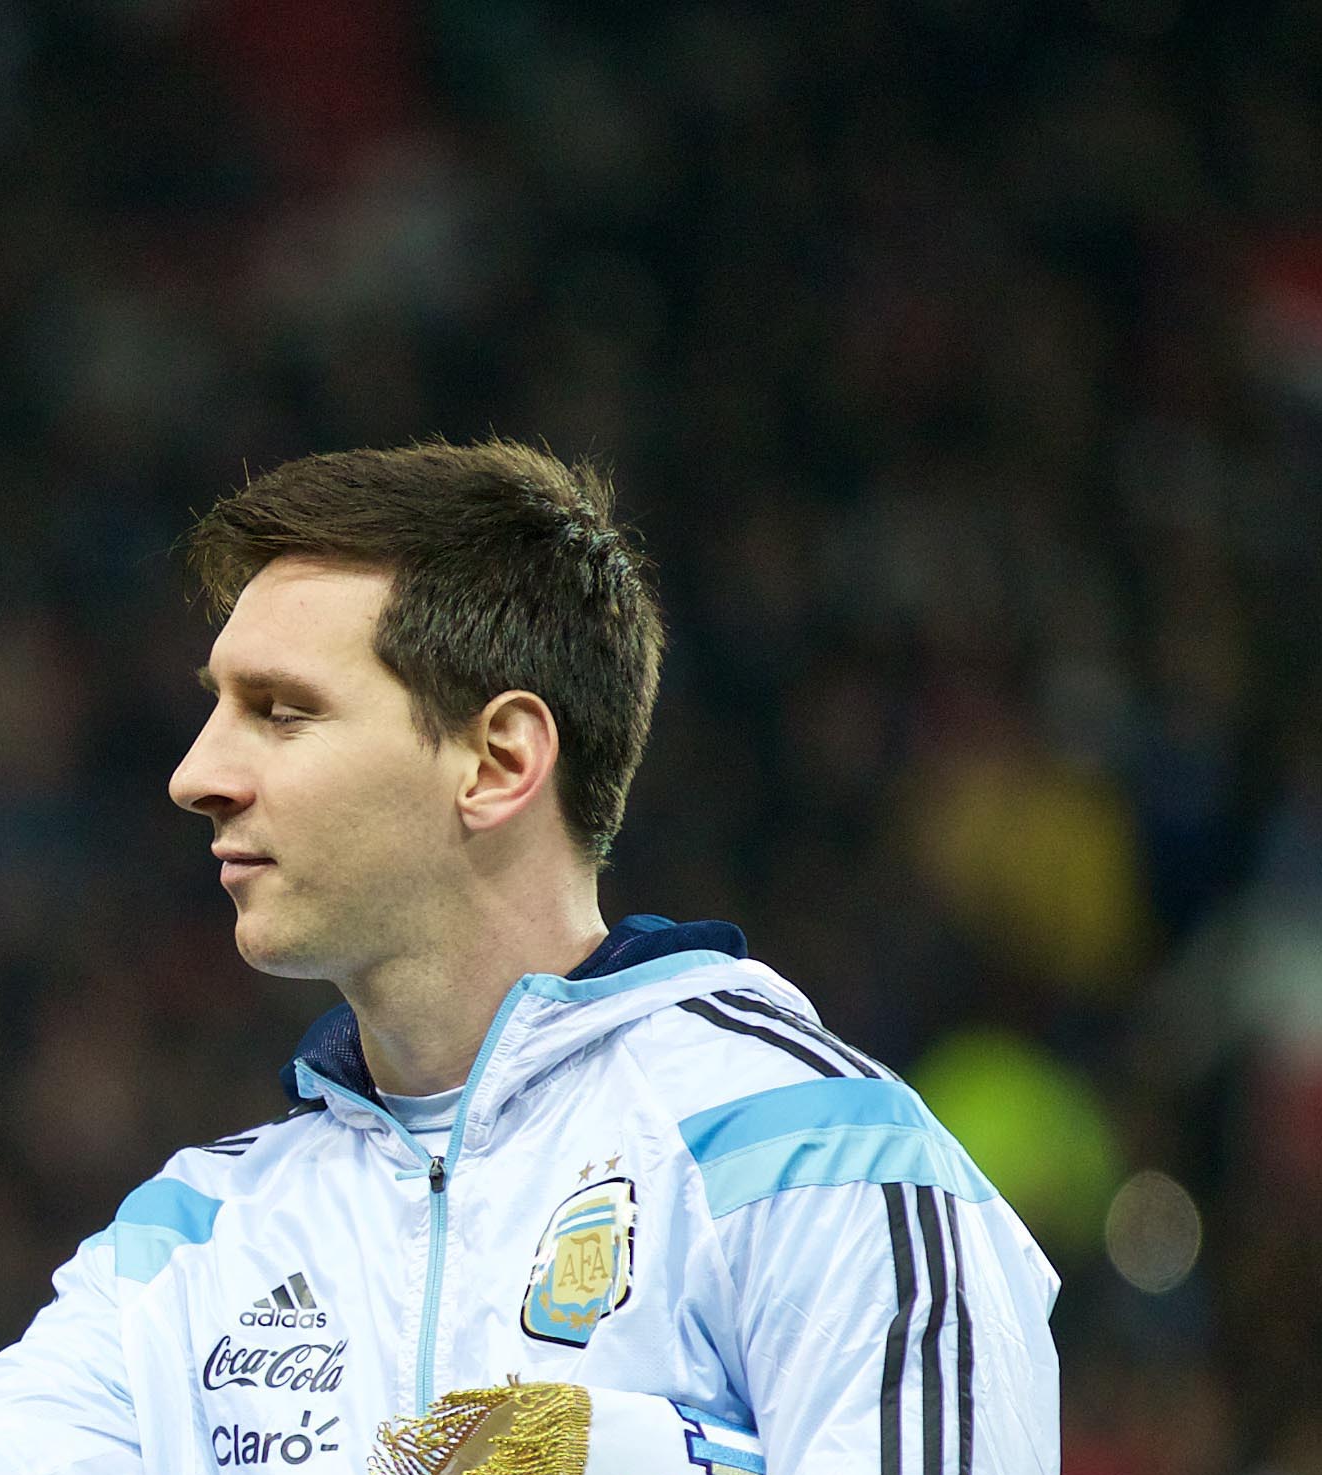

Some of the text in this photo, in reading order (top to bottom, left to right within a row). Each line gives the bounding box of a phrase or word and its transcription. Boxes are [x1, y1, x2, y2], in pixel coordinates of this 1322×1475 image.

[558, 1232, 609, 1293] AFA
[239, 1308, 327, 1328] adidas
[203, 1335, 349, 1392] Coca-Cola
[212, 1424, 313, 1466] Claro
